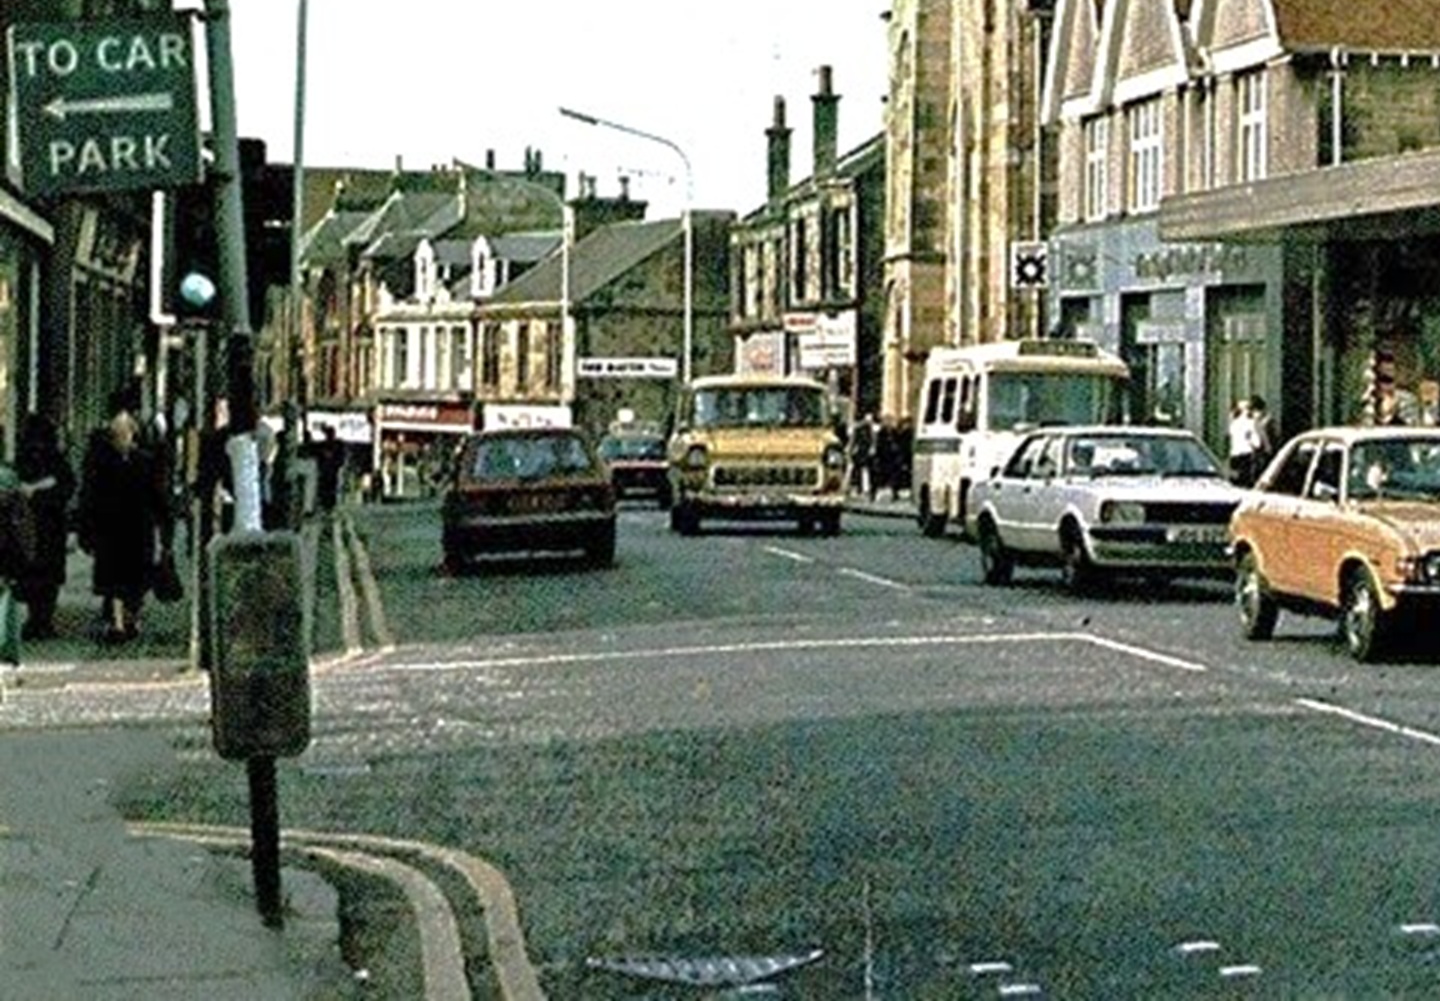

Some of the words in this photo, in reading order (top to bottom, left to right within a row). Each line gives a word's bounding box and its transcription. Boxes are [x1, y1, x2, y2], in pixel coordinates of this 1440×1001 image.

[16, 40, 78, 77] TO
[98, 34, 188, 70] CAR
[50, 133, 173, 175] PARK
